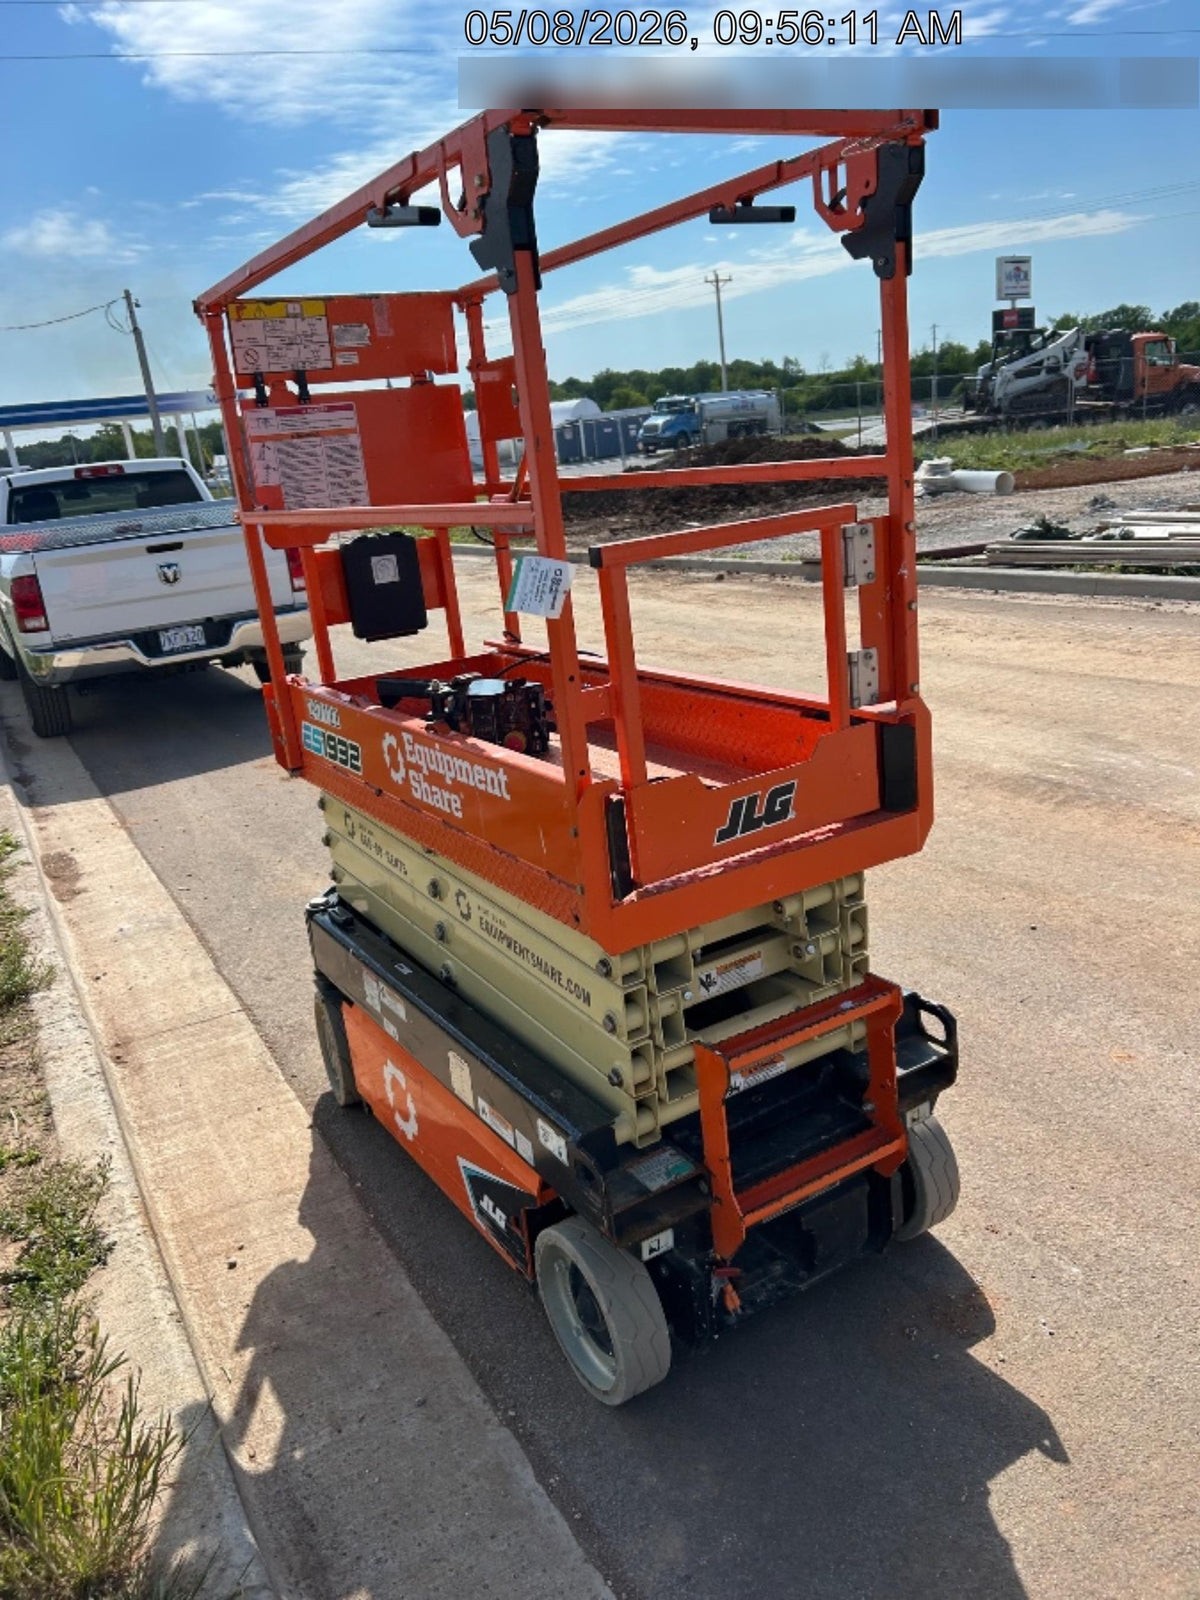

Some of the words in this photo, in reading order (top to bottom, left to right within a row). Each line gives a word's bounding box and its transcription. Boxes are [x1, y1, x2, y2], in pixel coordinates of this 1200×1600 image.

[302, 721, 363, 776] ES1932
[401, 731, 511, 801] Equipment
[409, 769, 463, 819] Share
[713, 779, 799, 847] JLG
[480, 1193, 507, 1231] JLG
